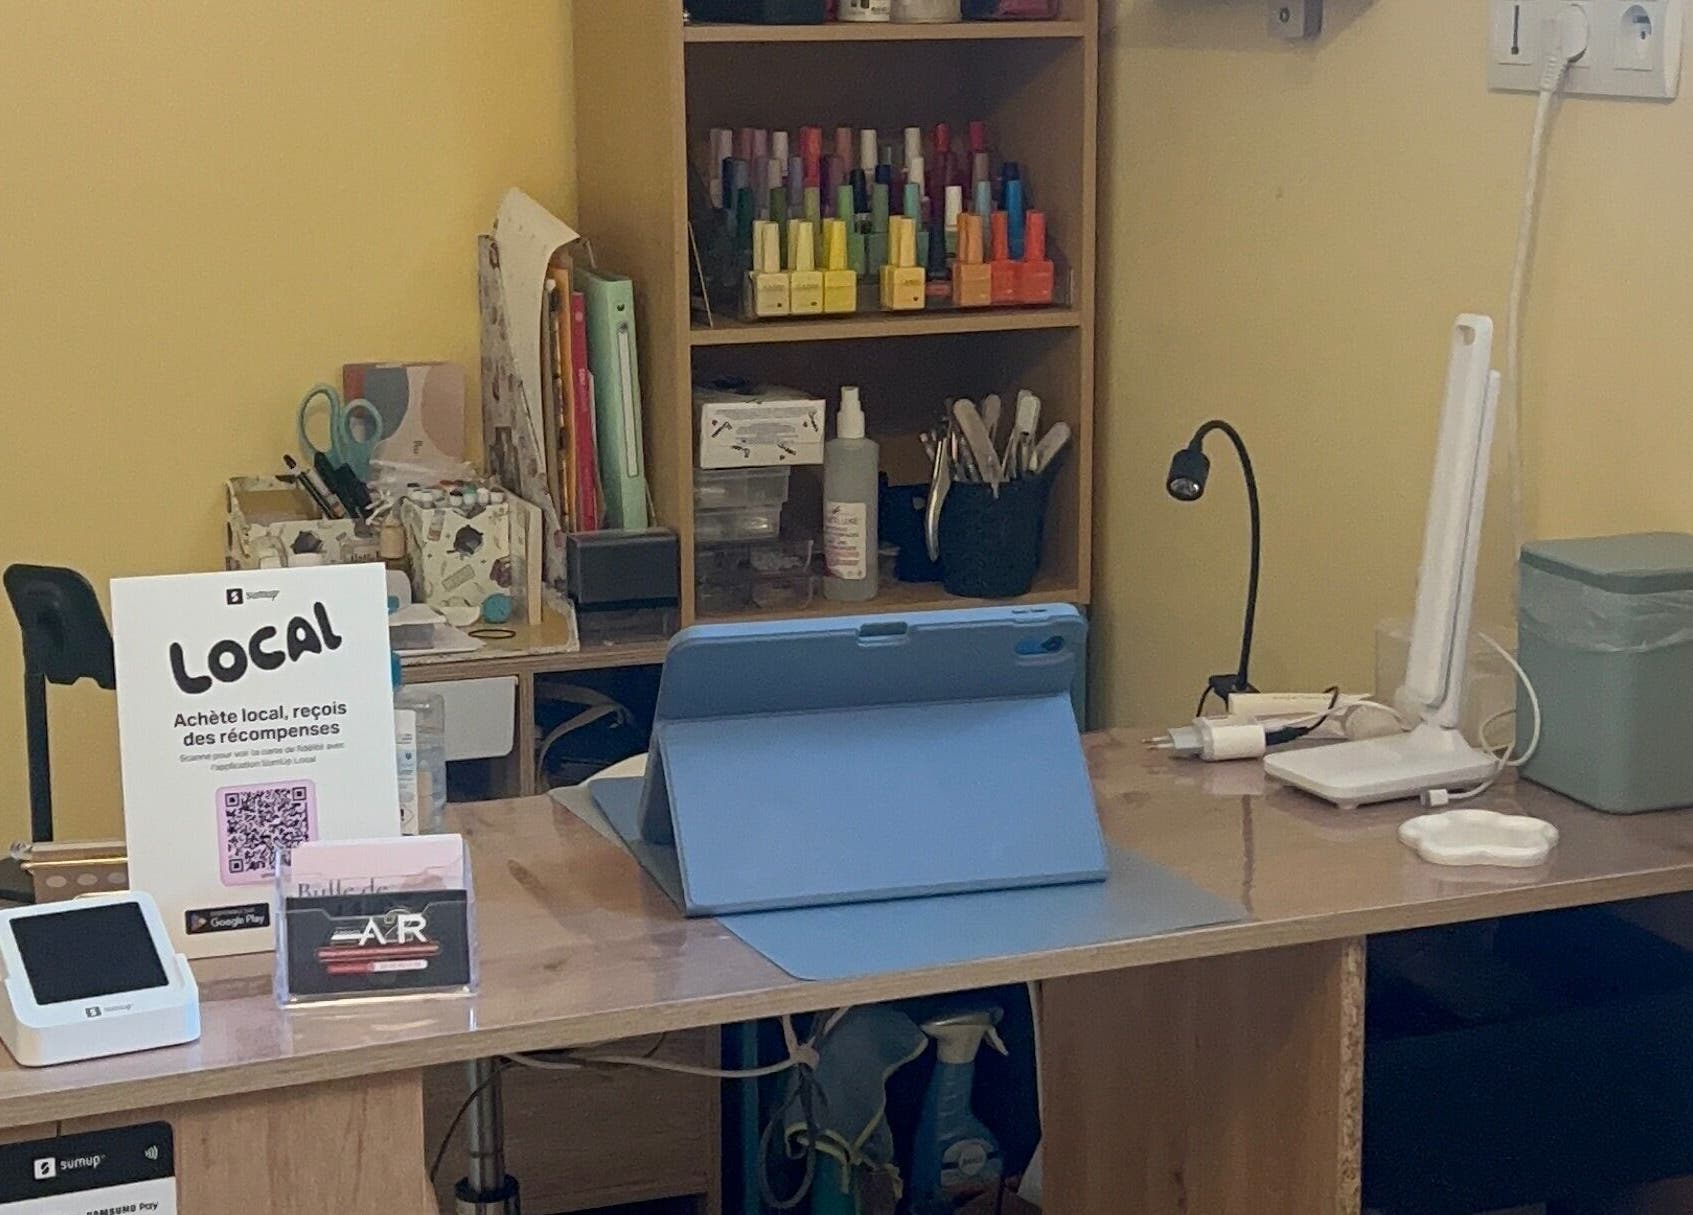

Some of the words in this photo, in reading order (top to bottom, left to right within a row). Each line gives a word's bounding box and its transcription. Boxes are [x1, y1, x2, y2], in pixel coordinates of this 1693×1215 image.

[170, 601, 342, 694] LOCAL
[174, 710, 238, 728] Achète
[242, 705, 288, 722] local,
[293, 701, 347, 720] reçois
[183, 732, 216, 747] des
[220, 723, 341, 743] récompenses
[180, 753, 213, 763] Scanne
[213, 751, 232, 761] pour
[234, 750, 249, 758] voir
[261, 748, 283, 756] carte
[285, 746, 295, 754] de
[210, 917, 245, 928] Google
[245, 914, 265, 925] Play
[139, 1201, 158, 1211] Pay
